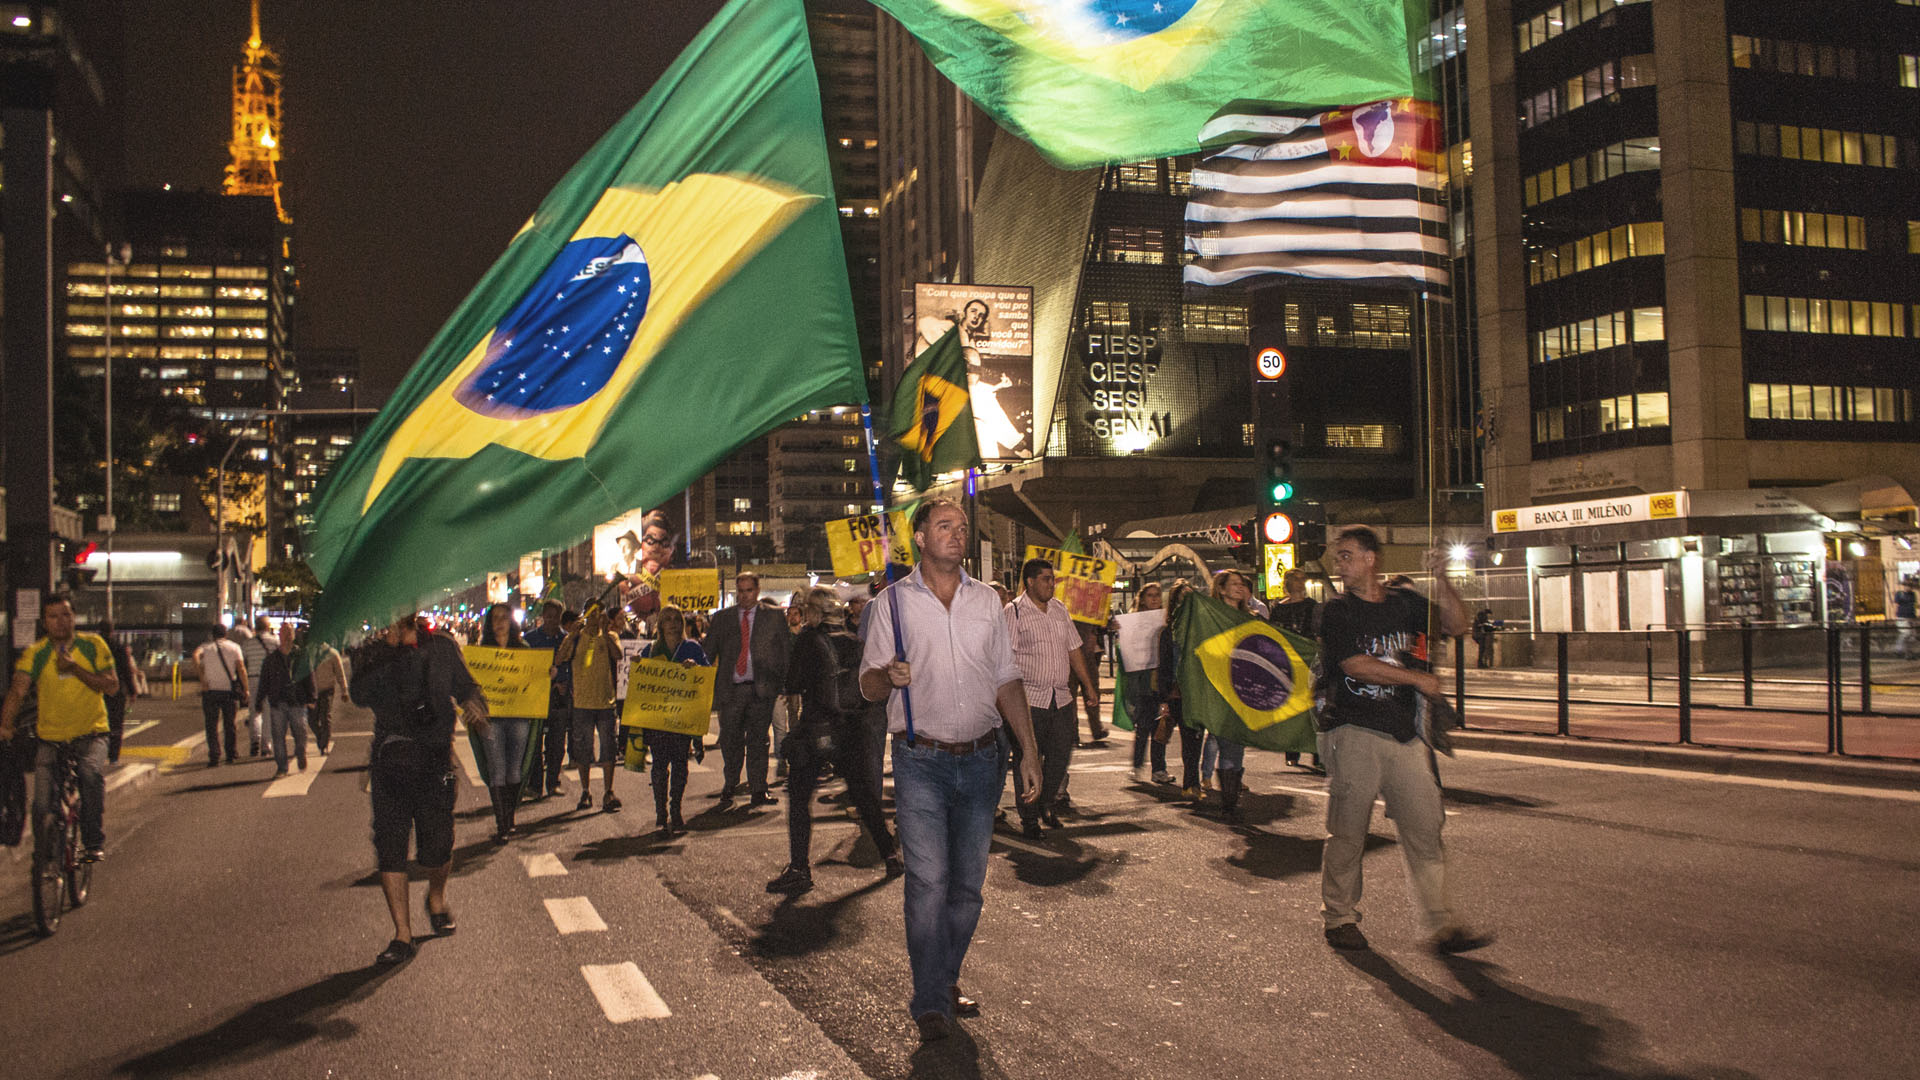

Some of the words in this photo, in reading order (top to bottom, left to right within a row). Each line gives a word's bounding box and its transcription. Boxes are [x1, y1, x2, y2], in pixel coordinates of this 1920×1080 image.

[950, 290, 968, 299] que
[969, 291, 996, 300] roupa
[997, 291, 1015, 301] que
[993, 302, 1012, 310] vou
[1012, 302, 1029, 311] pro
[998, 310, 1029, 320] samba
[991, 329, 1013, 339] você
[1014, 330, 1029, 339] me
[1011, 322, 1029, 331] que
[1089, 334, 1157, 357] FIESP
[1263, 355, 1280, 368] 50
[1090, 362, 1159, 384] CIESP
[1093, 389, 1145, 411] SESI
[1094, 416, 1167, 440] SENAI
[1652, 496, 1674, 512] veja
[1499, 512, 1517, 526] veja
[1534, 509, 1568, 525] BANCA
[1572, 507, 1583, 521] III
[1587, 502, 1632, 519] MILÊNIO
[848, 513, 896, 542] FORA
[637, 682, 698, 699] IMPEACHMENT
